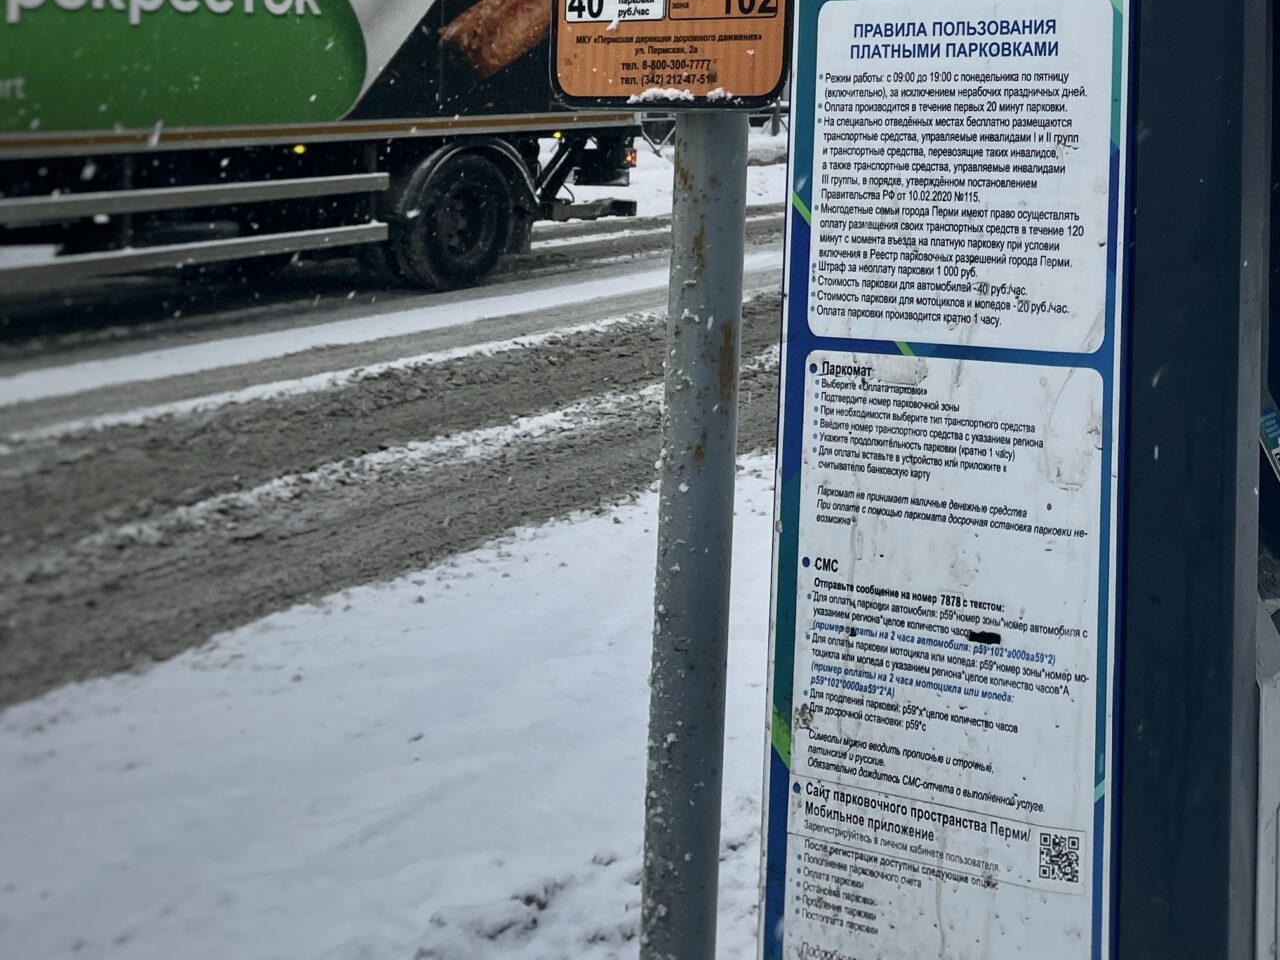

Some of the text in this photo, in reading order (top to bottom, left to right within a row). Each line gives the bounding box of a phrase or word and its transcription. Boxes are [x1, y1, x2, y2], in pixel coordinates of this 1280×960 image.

[618, 6, 649, 18] руб./час
[672, 1, 689, 9] зона
[854, 20, 1056, 38] ПРАВИЛА ПОЛЬЗОВАНИЯ
[850, 41, 1059, 60] ПЛАТНЫМИ ПАРКОВКАМИ
[621, 59, 711, 70] тел. 8-800-300-7777
[621, 75, 638, 85] тел.
[641, 74, 664, 86] (342)
[825, 70, 1069, 84] Режим работы: с 09:00 до 19:00 с понедельника по пятницу
[824, 85, 1087, 98] (включительно), за исключением нерабочих праздничных дней.
[824, 100, 1067, 114] Оплата производится в течение первых 20 минут парковки.
[822, 362, 872, 377] Паркомат
[815, 558, 838, 573] СМС
[814, 577, 1005, 612] Отправьте сообщение на номер 7878 с текстом:
[805, 782, 1031, 841] Сайт парковочного пространства Перми/
[804, 801, 934, 841] Мобильное приложение
